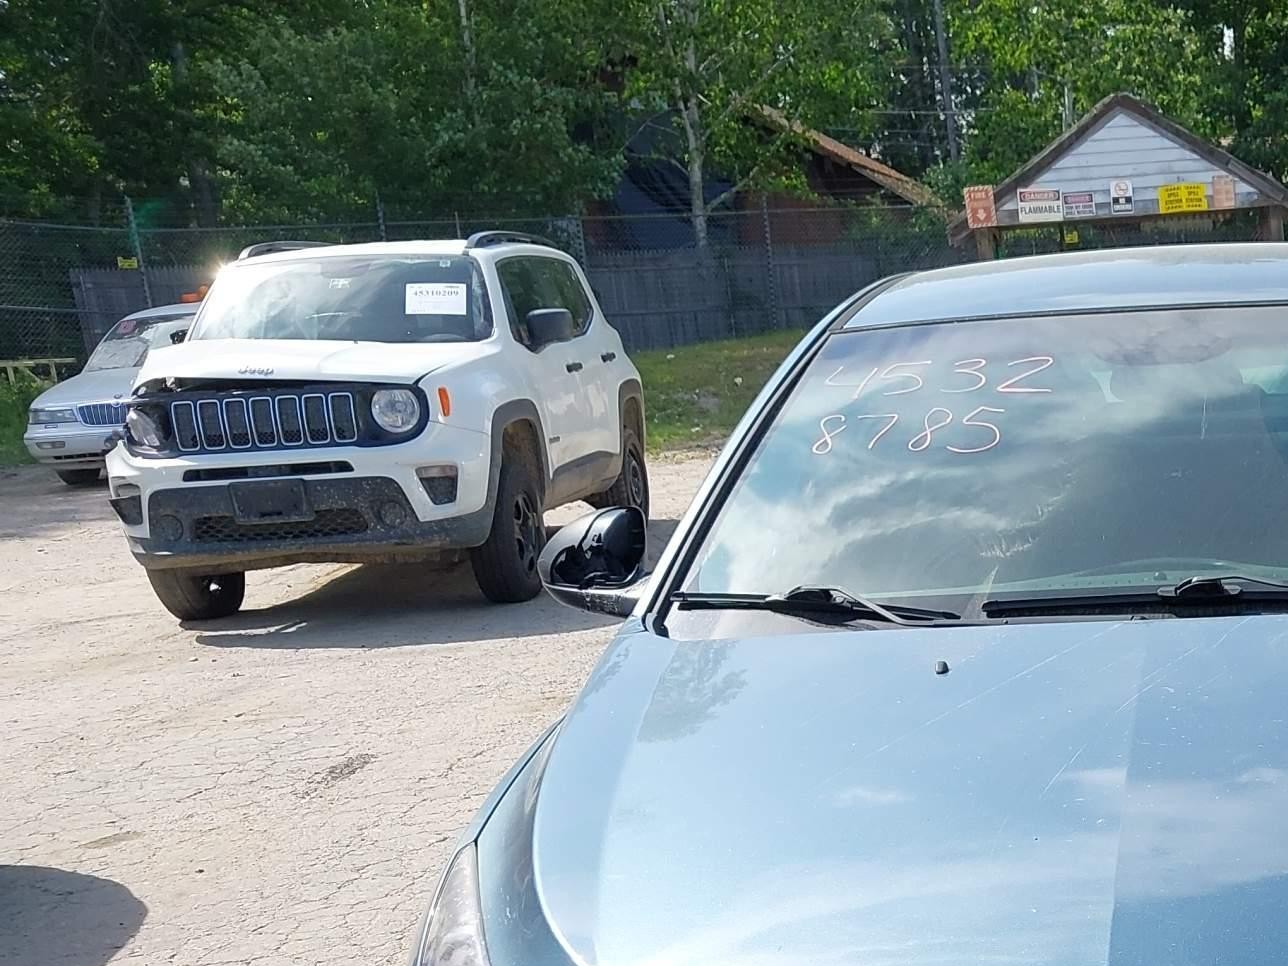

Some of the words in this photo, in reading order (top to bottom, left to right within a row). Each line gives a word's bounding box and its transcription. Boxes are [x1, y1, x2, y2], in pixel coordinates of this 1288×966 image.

[1020, 204, 1062, 215] FLAMMABLE
[825, 356, 1054, 400] 4532
[812, 406, 1005, 454] 8785
